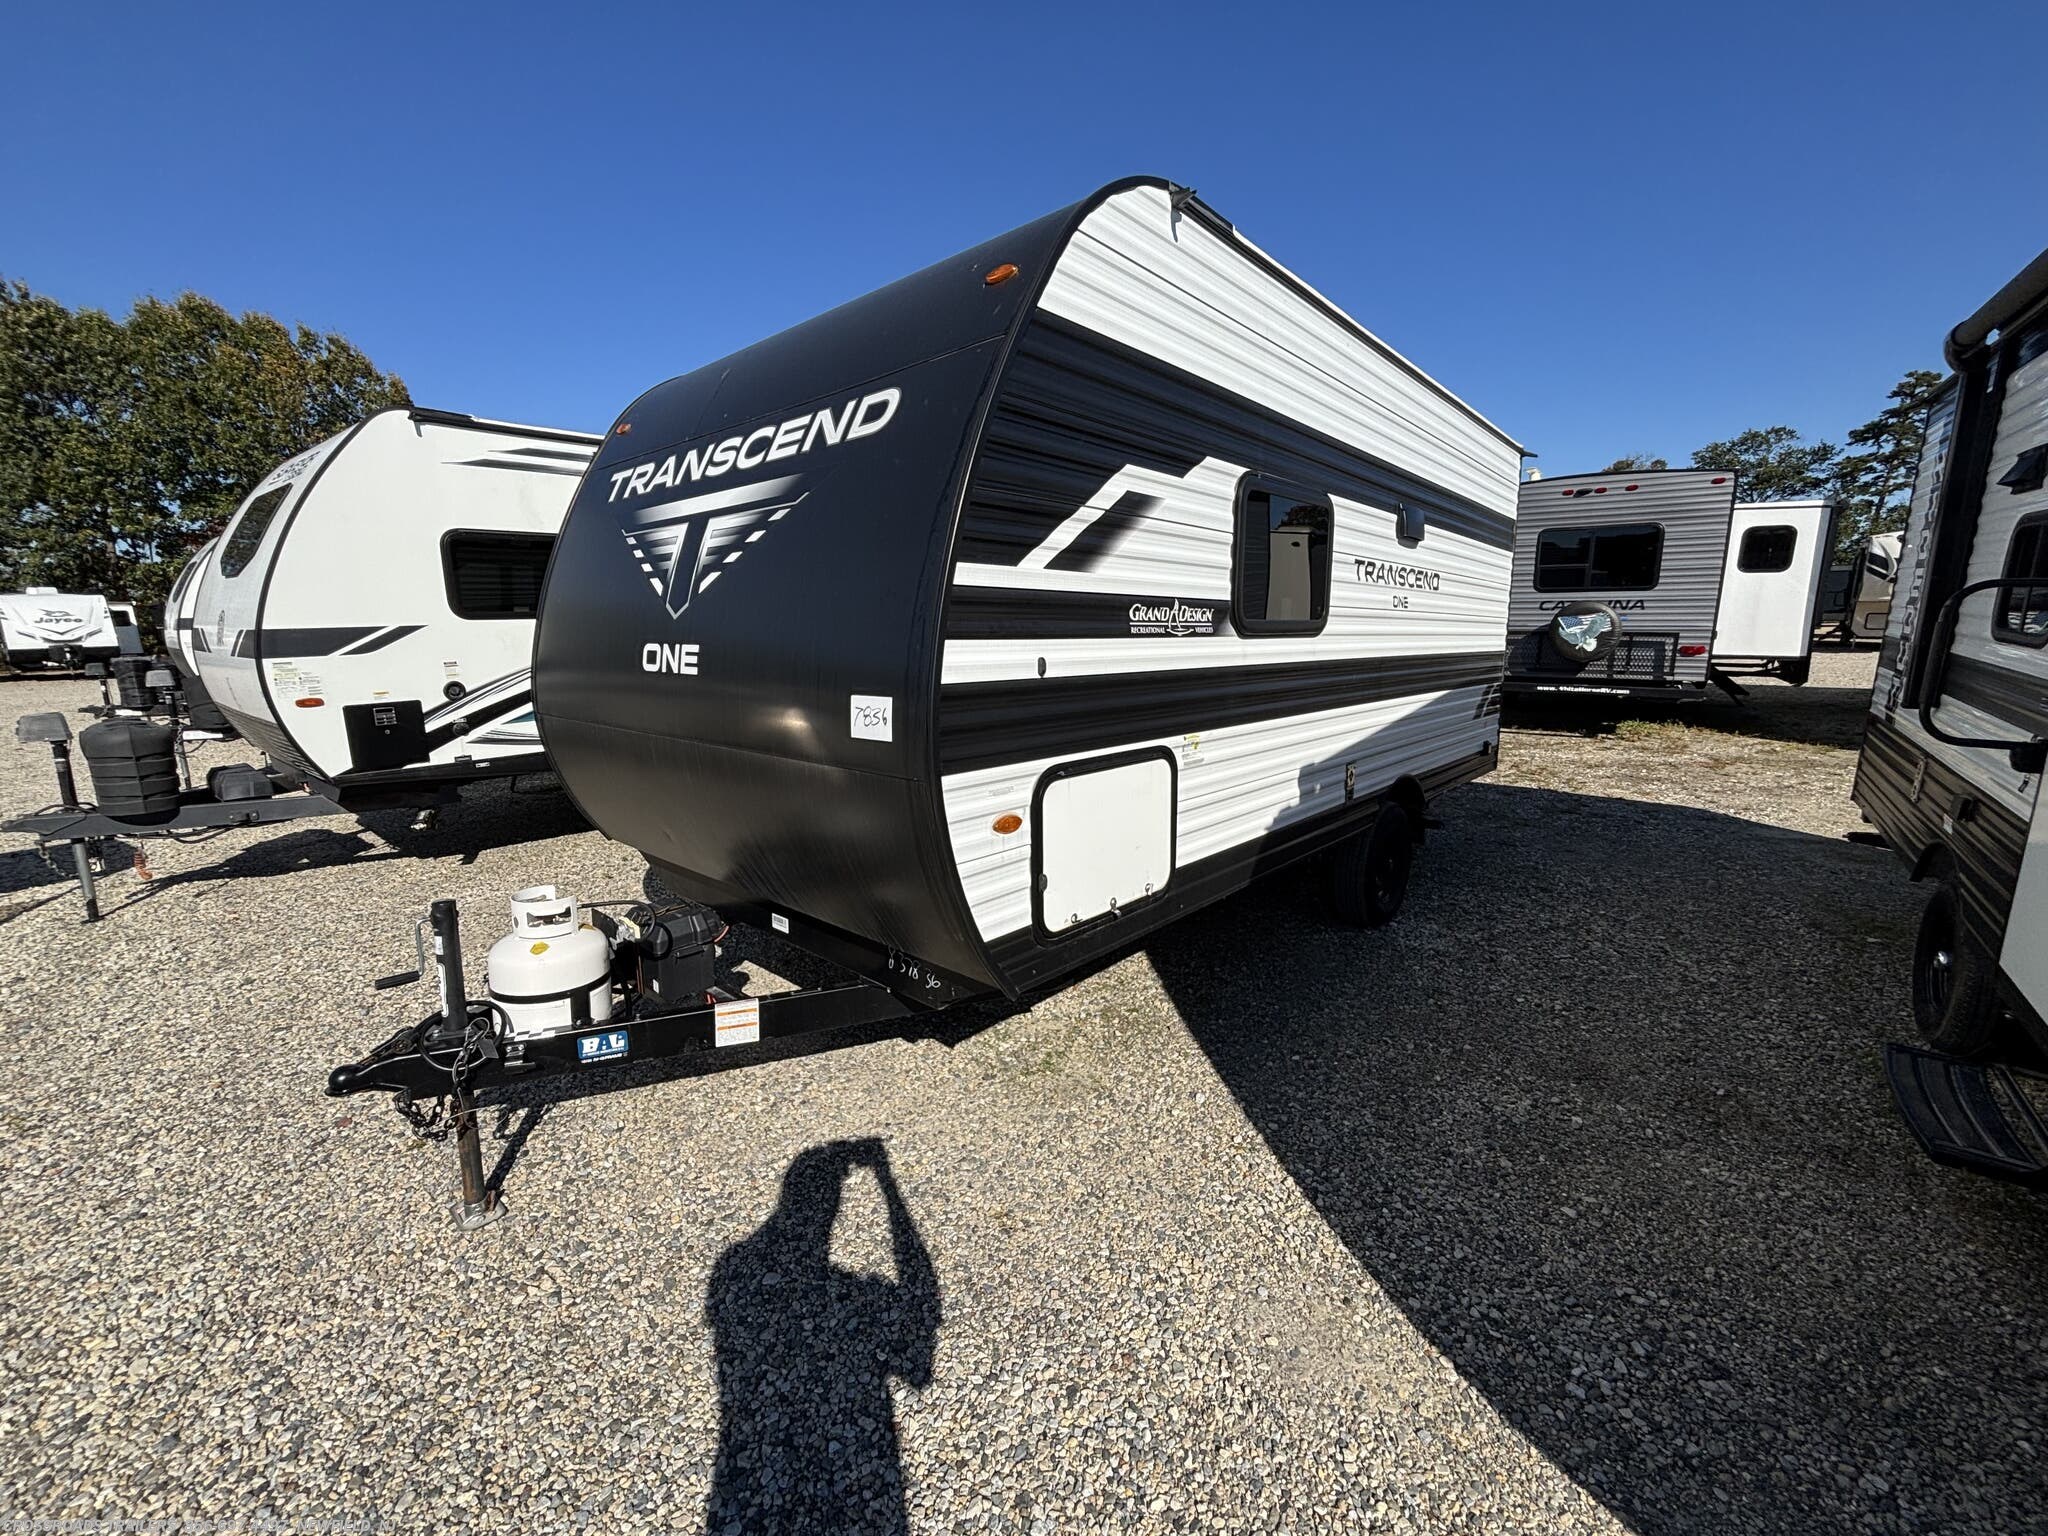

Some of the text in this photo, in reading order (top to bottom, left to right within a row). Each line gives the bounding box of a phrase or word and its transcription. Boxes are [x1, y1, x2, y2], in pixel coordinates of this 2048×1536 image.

[608, 387, 902, 503] TRANSCEND
[1354, 558, 1441, 591] TRANSCEND
[1129, 603, 1215, 622] GRAND DESIGN
[1392, 595, 1409, 609] ONE
[1539, 600, 1646, 611] CAINA
[642, 643, 699, 676] ONE
